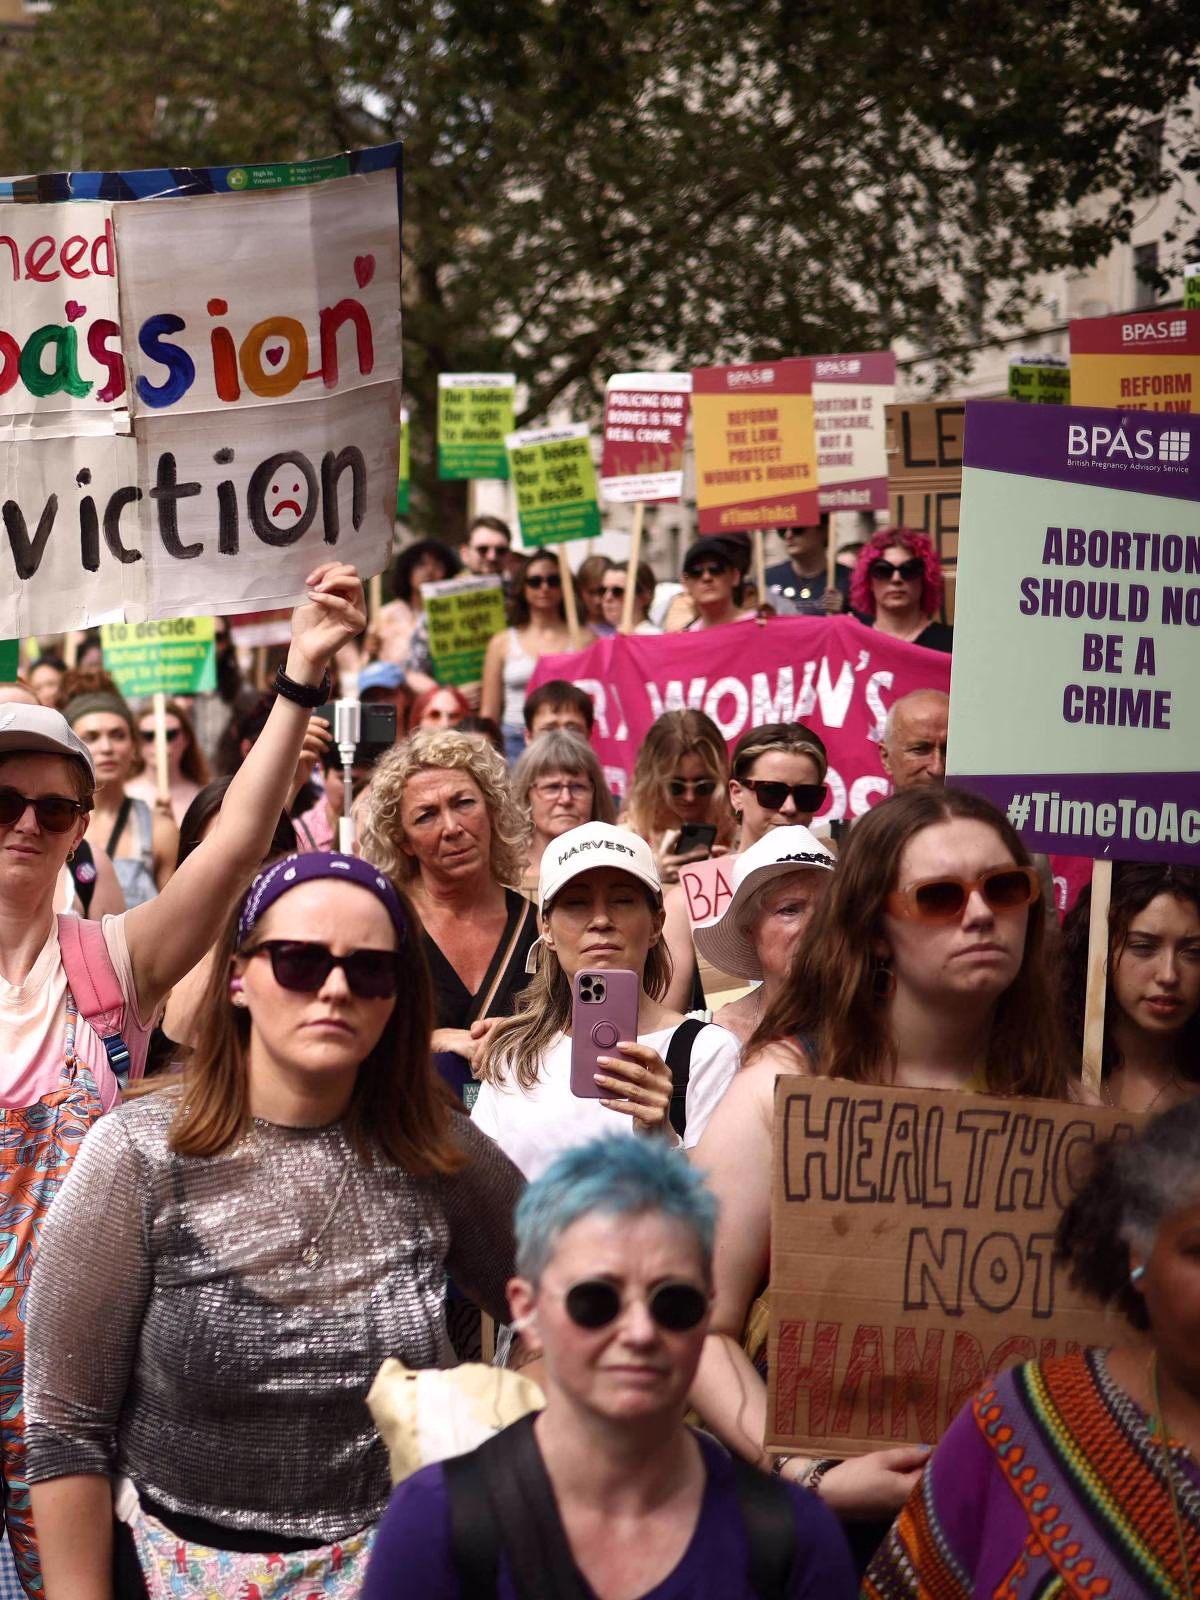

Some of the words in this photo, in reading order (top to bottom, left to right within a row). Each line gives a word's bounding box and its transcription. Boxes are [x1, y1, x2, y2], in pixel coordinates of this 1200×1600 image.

[1121, 321, 1168, 341] BPAS
[726, 369, 760, 386] BPAS
[815, 361, 847, 377] BPAS
[1120, 373, 1192, 398] REFORM
[609, 391, 660, 408] POLICING
[661, 393, 684, 409] OUR
[607, 409, 648, 425] BODIES
[662, 411, 683, 427] THE
[727, 408, 779, 426] REFORM
[606, 427, 635, 441] REAL
[635, 428, 672, 444] CRIME
[726, 430, 747, 444] THE
[820, 435, 841, 448] NOT
[1067, 425, 1154, 460] BPAS
[728, 447, 782, 464] PROTECT
[1067, 458, 1089, 467] British
[1091, 459, 1127, 472] Pregnancy
[1130, 462, 1160, 474] Advisory
[1163, 463, 1189, 474] Service
[703, 467, 762, 485] WOMEN'S
[766, 463, 811, 481] RIGHTS
[720, 504, 798, 527] #TimeToAct
[1019, 577, 1150, 623] SHOULD
[135, 617, 196, 639] decide
[1082, 633, 1124, 674] BE
[1134, 636, 1156, 677] A
[1062, 683, 1171, 730] CRIME
[558, 840, 636, 865] HARVEST
[783, 1094, 1134, 1213] HEALTHC
[903, 1227, 1056, 1320] NOT
